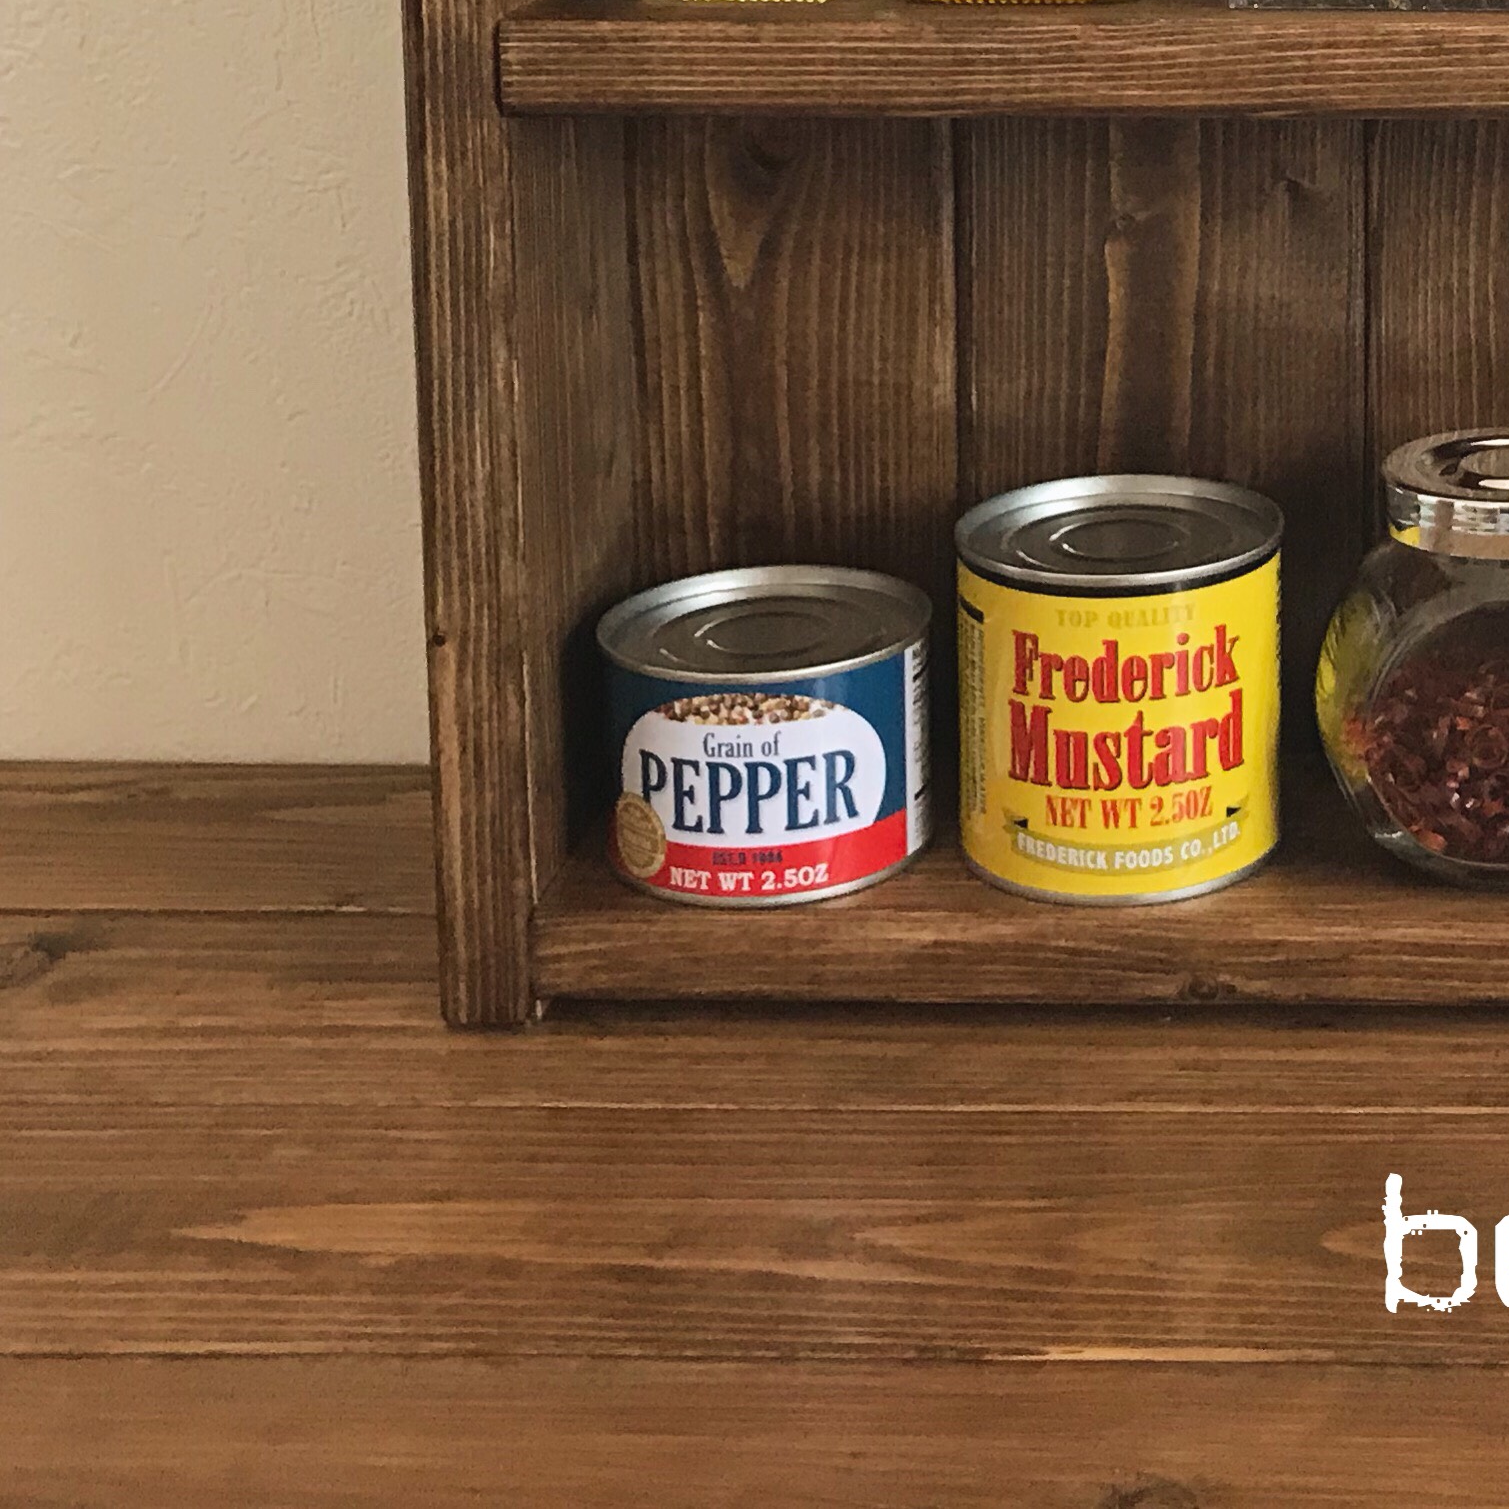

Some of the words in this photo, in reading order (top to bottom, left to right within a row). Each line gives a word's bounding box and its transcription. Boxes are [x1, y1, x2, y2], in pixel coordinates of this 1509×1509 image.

[1054, 607, 1098, 628] TOP
[1107, 602, 1197, 628] QUALITY
[1011, 623, 1240, 704] Frederick
[702, 732, 753, 758] Grain
[761, 731, 782, 757] of
[1008, 688, 1245, 791] Mustard
[639, 748, 860, 835] PEPPER
[1045, 794, 1092, 829] NET
[1100, 797, 1142, 829] WT
[1016, 832, 1108, 870] FREDERICK
[1114, 845, 1174, 870] FOODS
[669, 866, 712, 890] NET
[718, 871, 754, 891] WT
